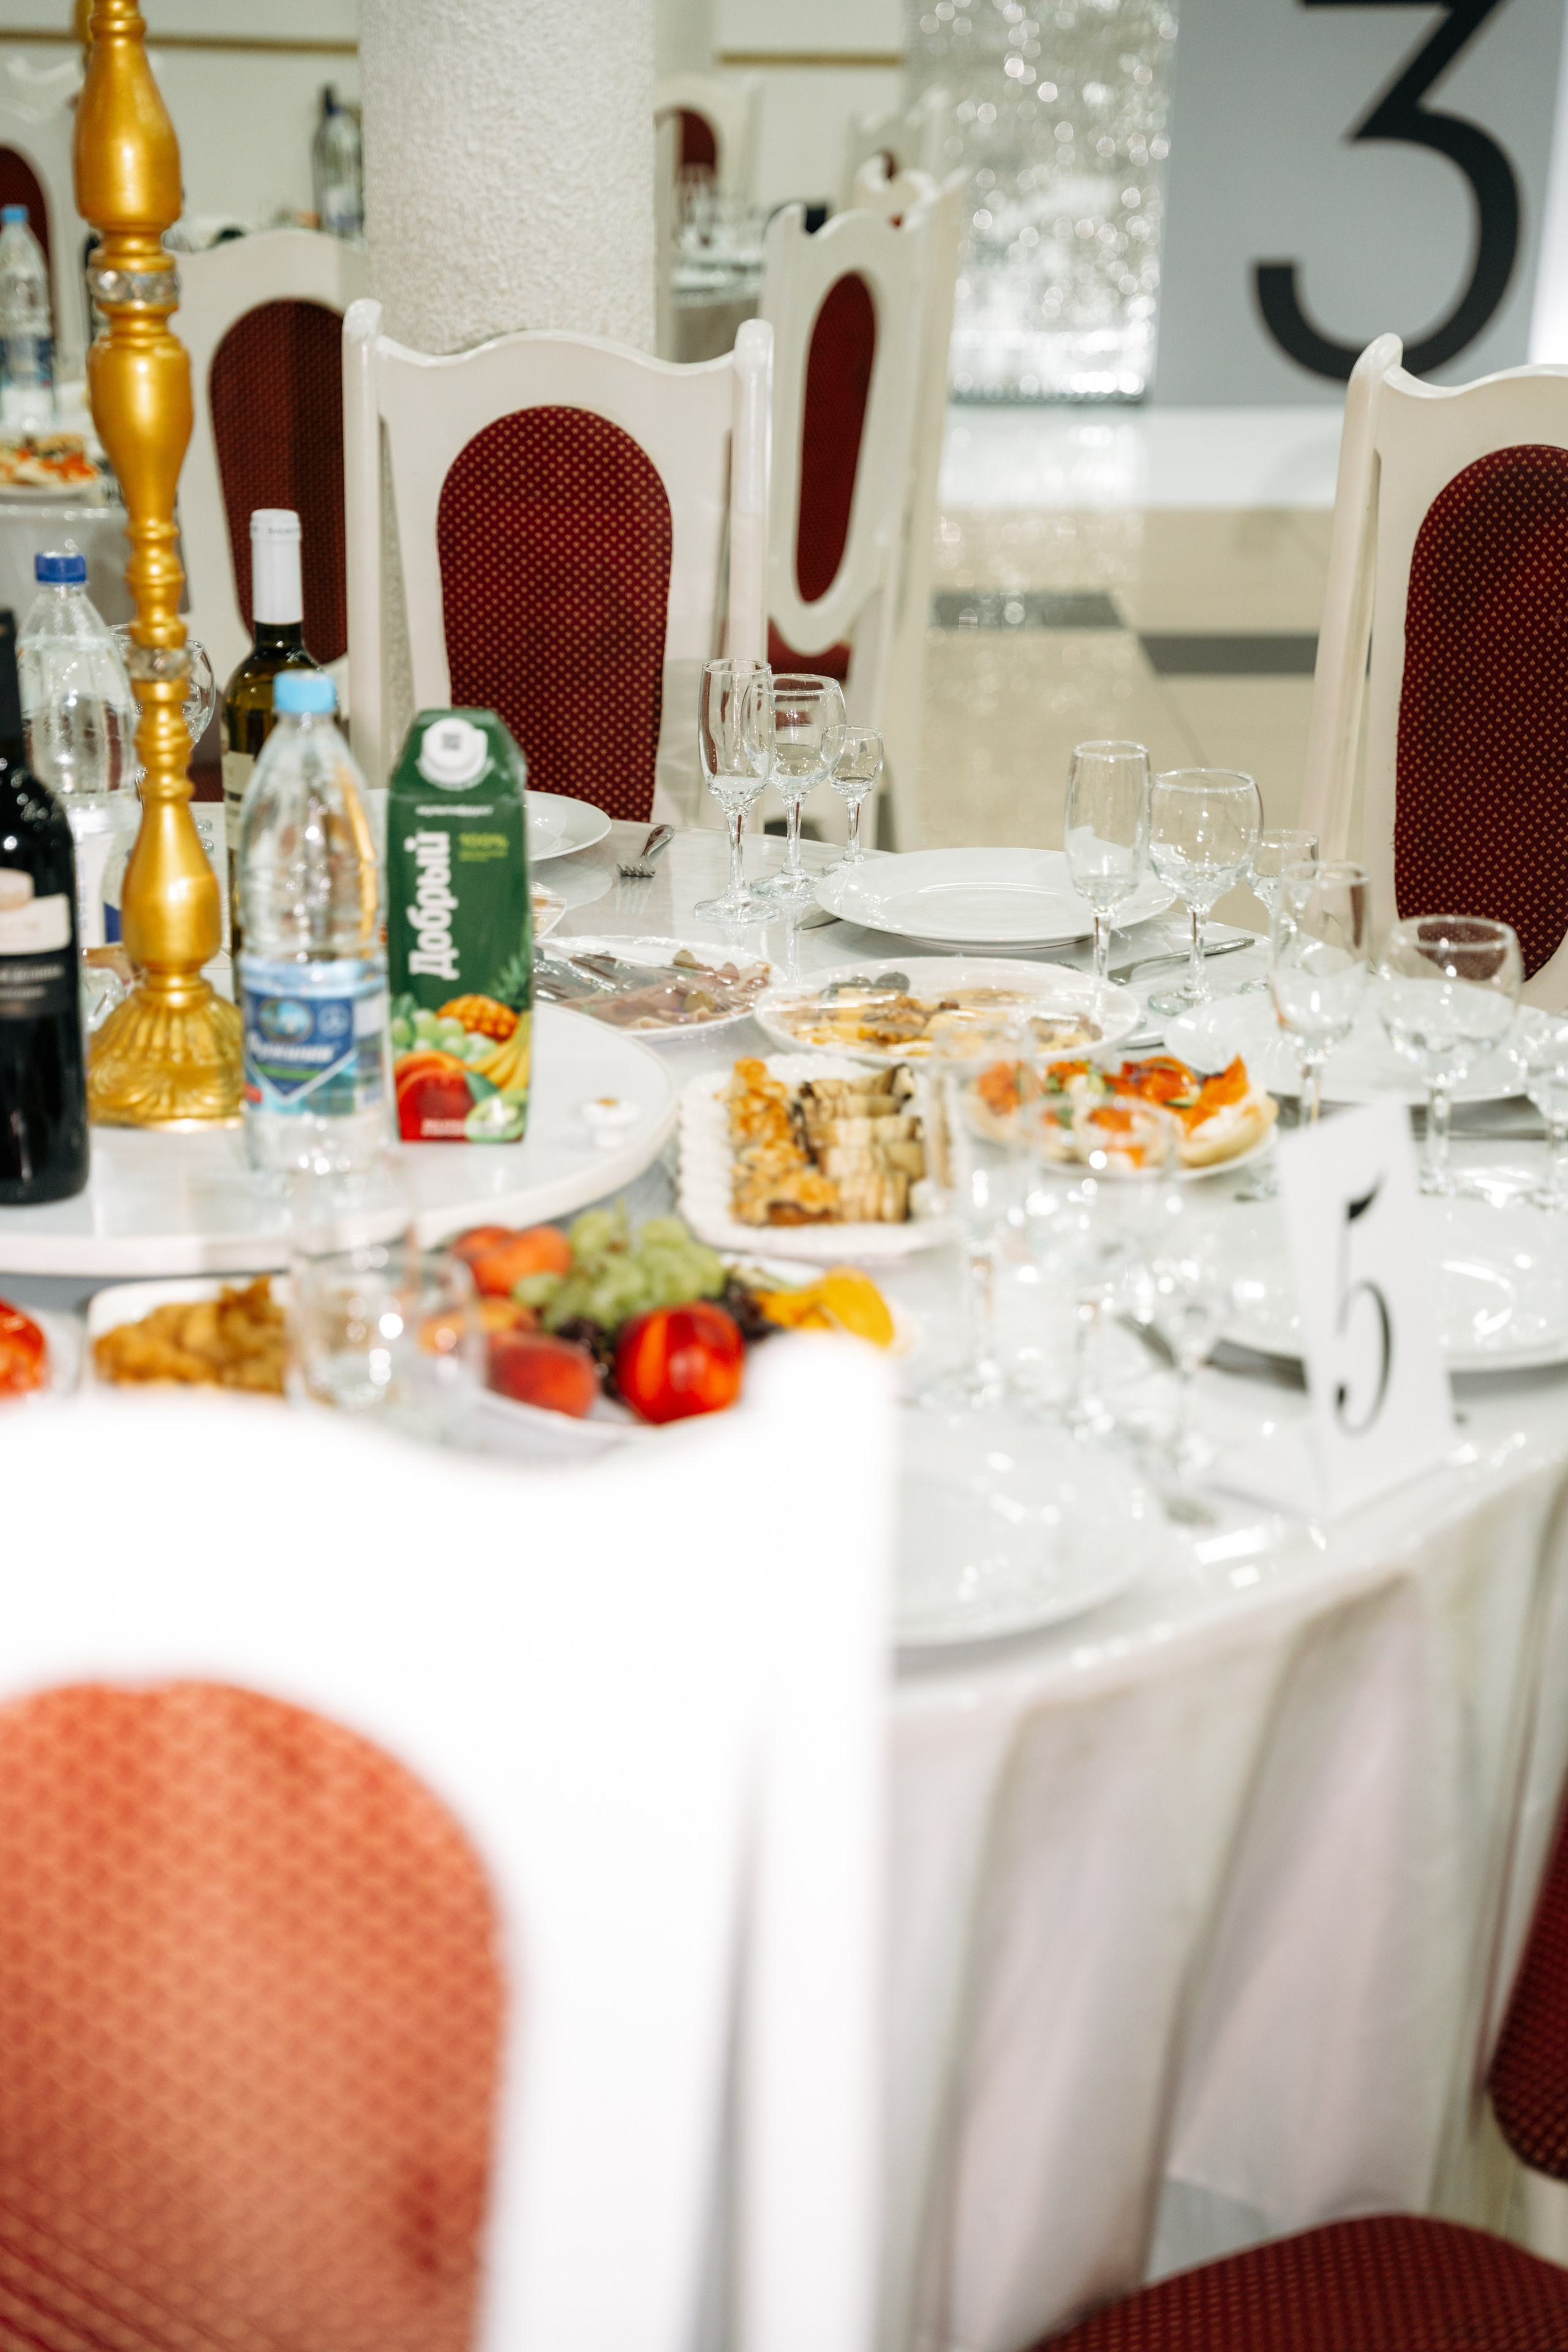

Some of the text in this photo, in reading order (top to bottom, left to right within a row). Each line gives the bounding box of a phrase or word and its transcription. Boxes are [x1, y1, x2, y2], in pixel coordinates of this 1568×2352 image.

[1250, 0, 1523, 383] 3
[404, 831, 459, 981] Добрый
[1335, 1173, 1393, 1438] 5
